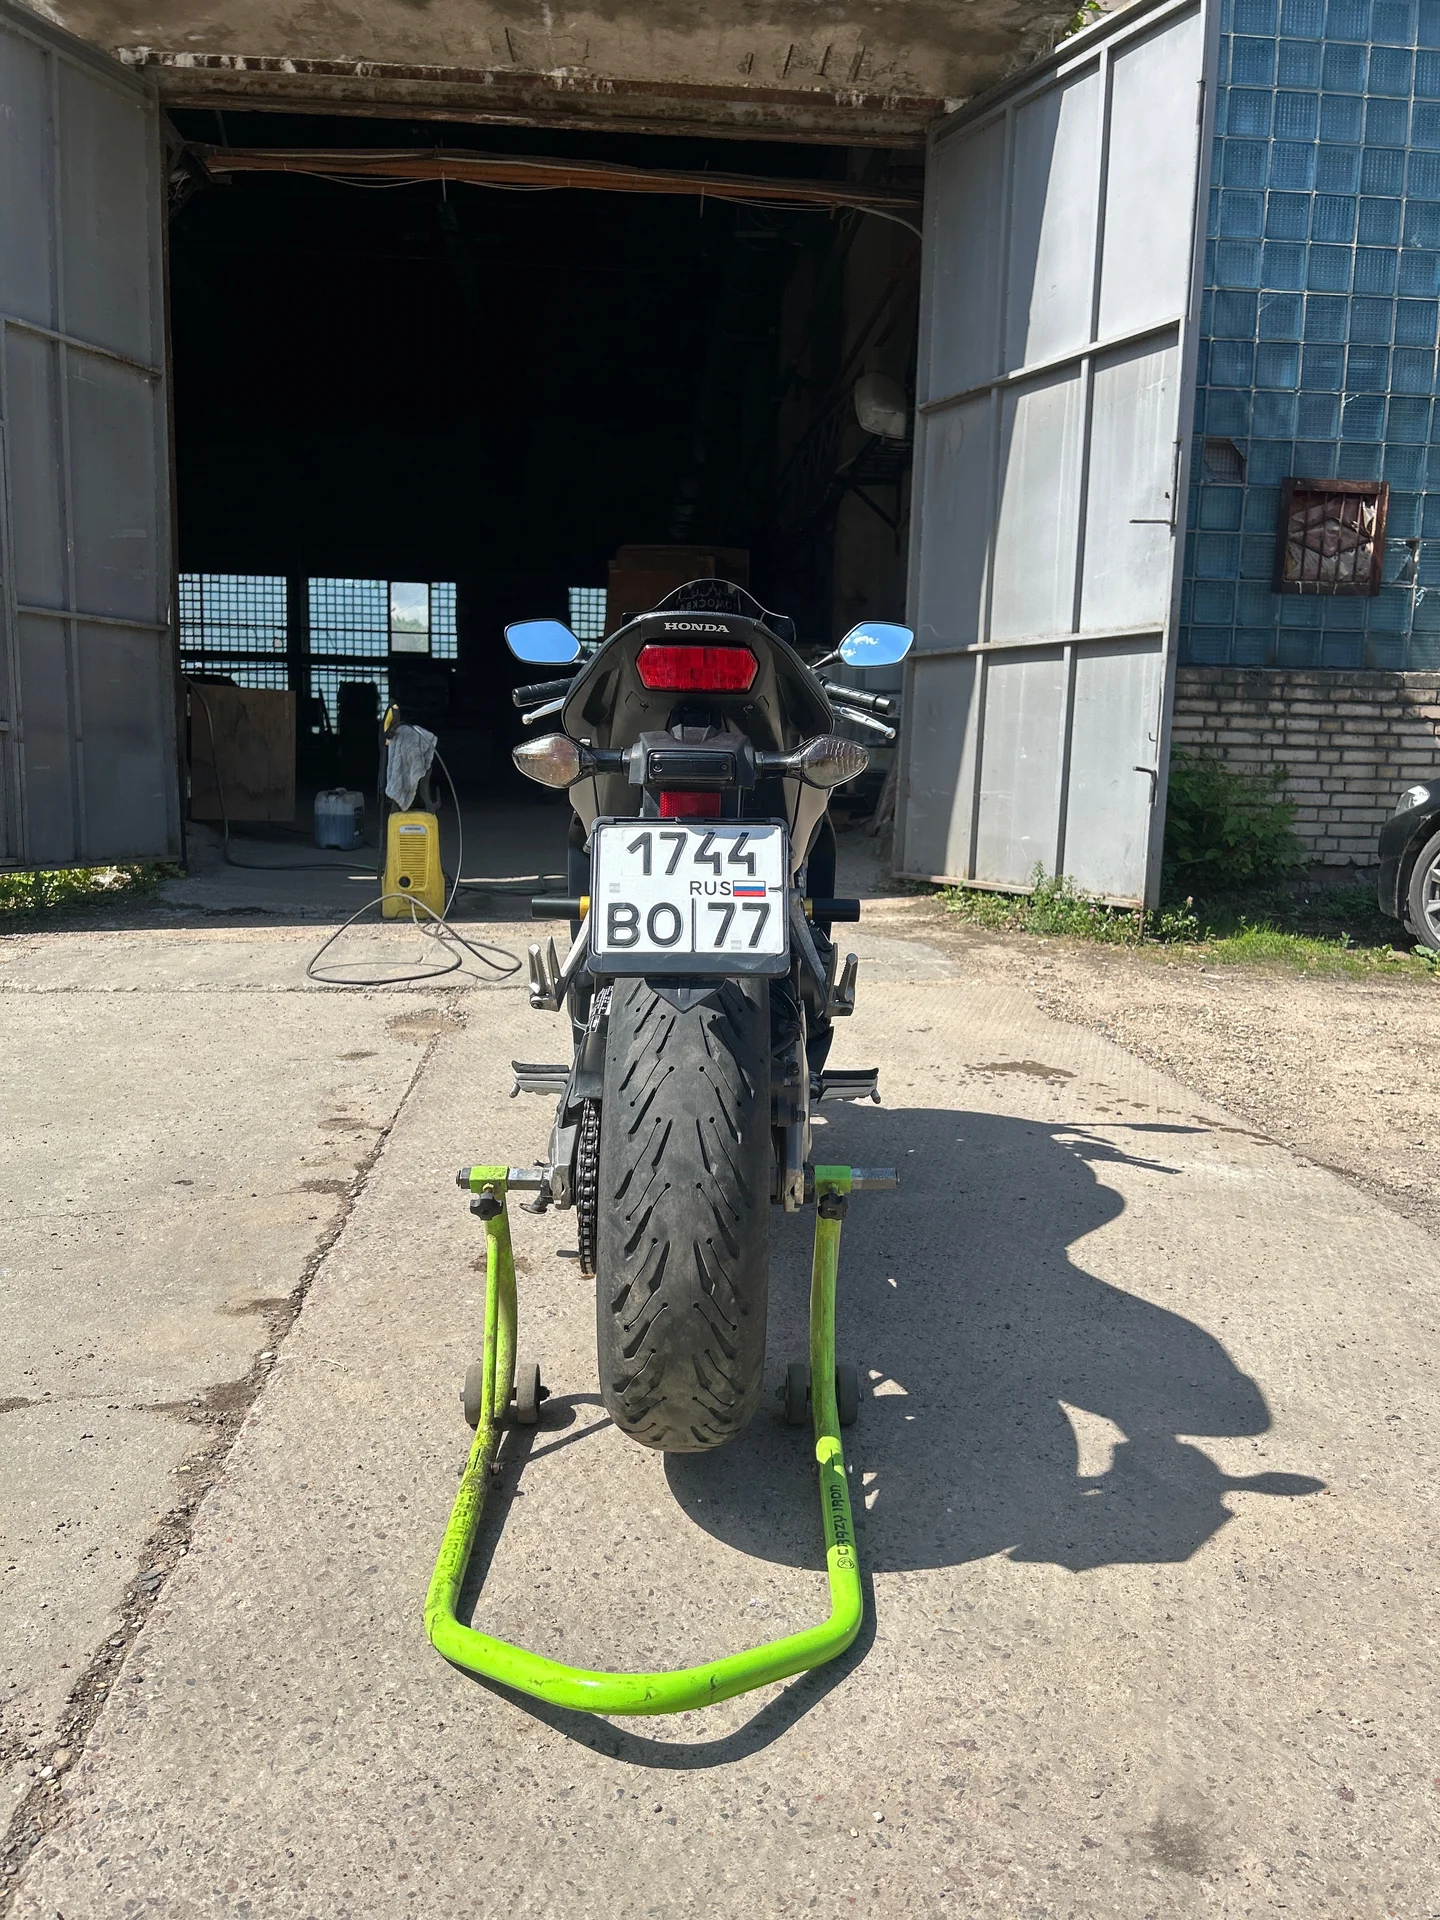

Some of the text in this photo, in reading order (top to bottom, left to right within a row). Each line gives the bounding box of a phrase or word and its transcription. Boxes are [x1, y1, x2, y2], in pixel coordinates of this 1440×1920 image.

[664, 622, 729, 633] HONDA
[626, 832, 756, 876] 1744
[689, 881, 732, 896] RUS
[707, 902, 771, 948] 77
[830, 1485, 850, 1556] CRAZY IRON
